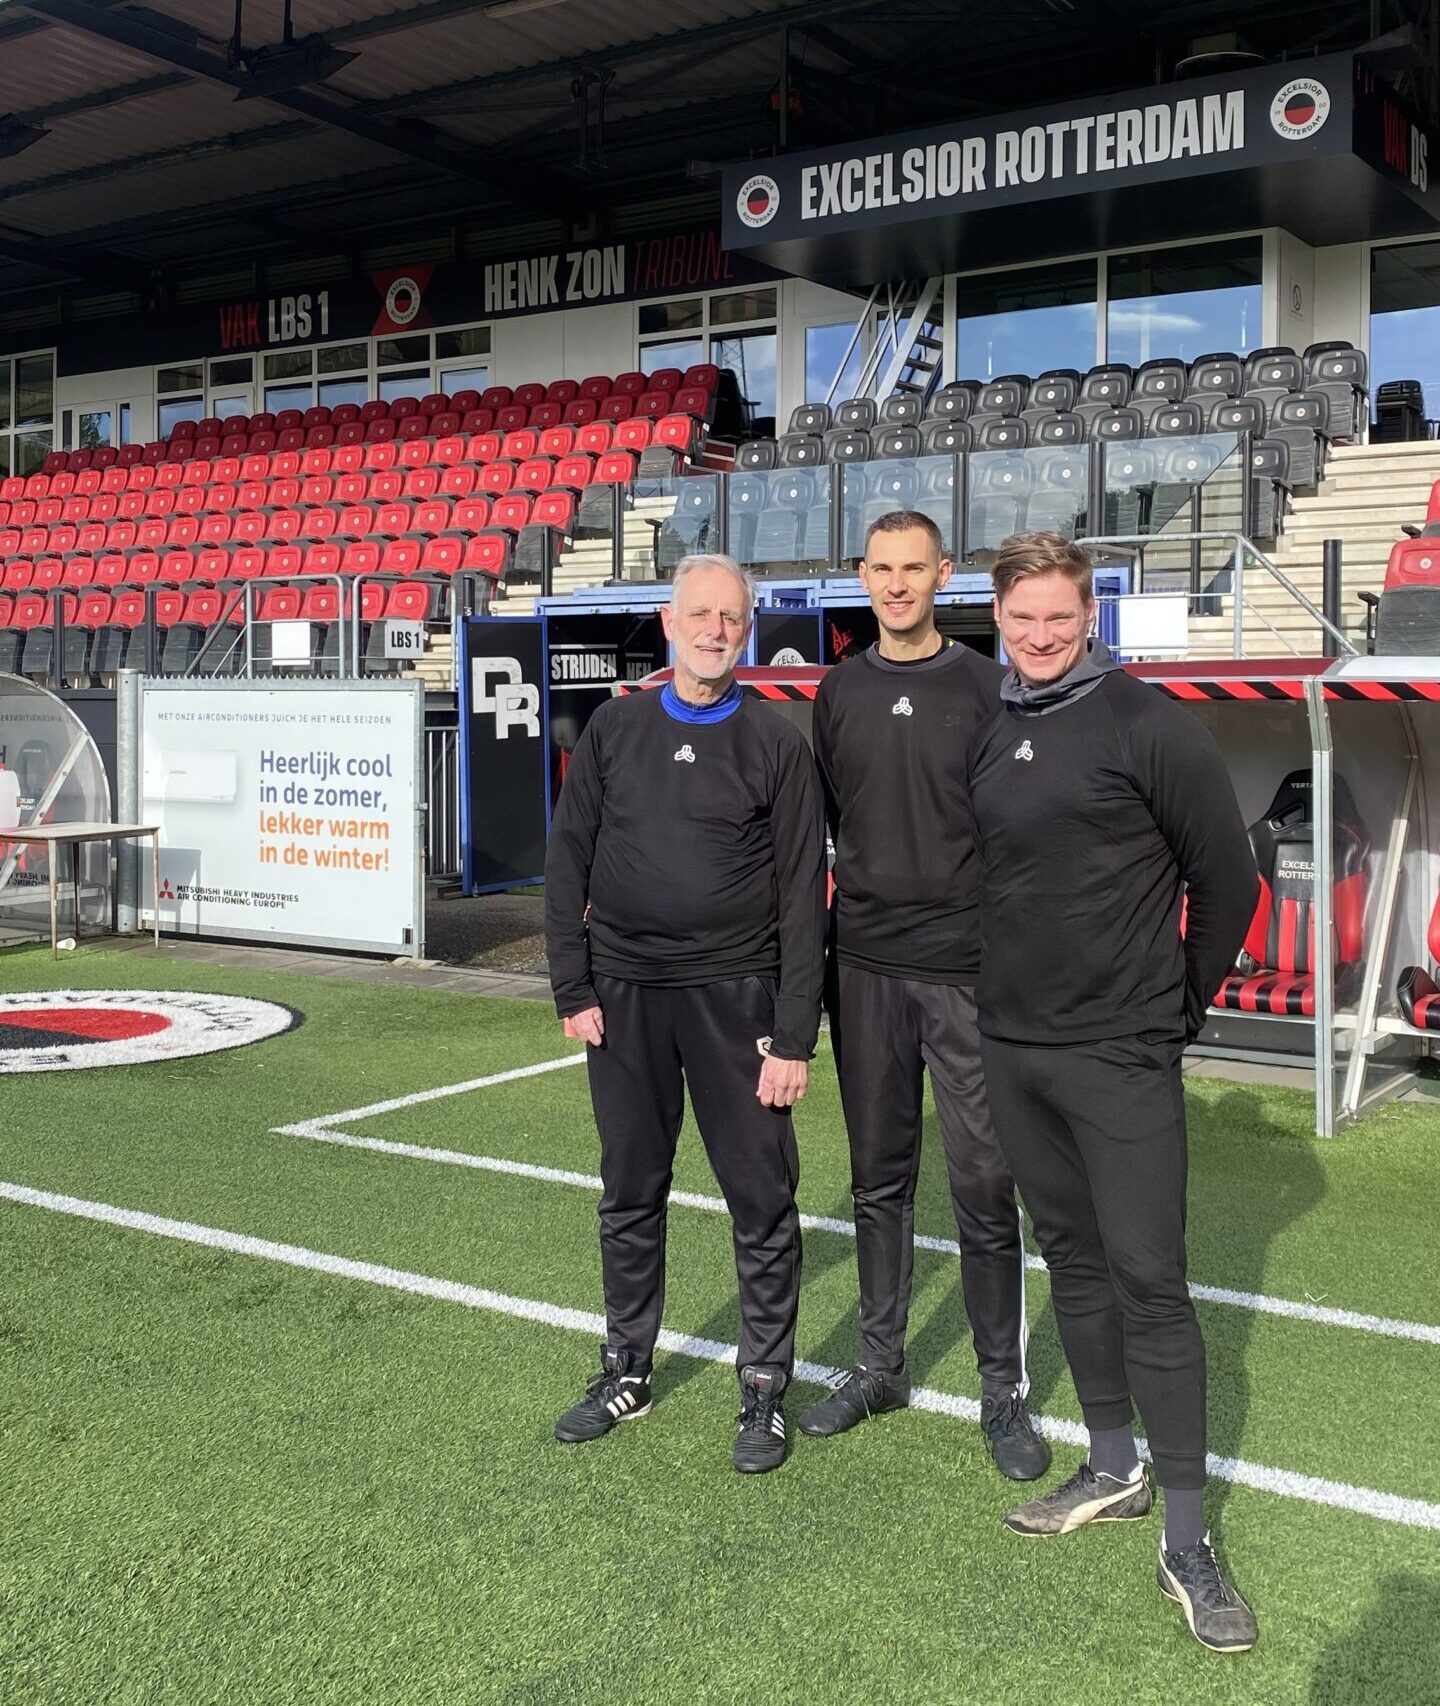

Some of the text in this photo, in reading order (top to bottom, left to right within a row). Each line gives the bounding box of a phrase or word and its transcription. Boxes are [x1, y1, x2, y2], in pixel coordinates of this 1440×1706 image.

[1278, 82, 1322, 104] EXCELSIOR
[1278, 115, 1322, 136] ROTTERDAM
[801, 90, 1245, 220] EXCELSIOR ROTTERDAM
[1411, 124, 1428, 193] DS
[742, 179, 775, 196] EXCELSIOR
[743, 207, 775, 224] ROTTERDAM
[484, 255, 560, 312] HENK
[566, 245, 625, 300] ZON
[219, 290, 329, 349] VAK LBS 1
[391, 631, 420, 649] LBS 1
[551, 653, 618, 681] STRIJDEN
[158, 712, 392, 725] MET ONZE AIRCONDITIONERS JUICH JE HET HELE SEIZOEN
[260, 750, 392, 781] Heerlijk cool
[260, 780, 387, 812] in de zomer,
[260, 810, 389, 840] lekker warm
[260, 840, 389, 872] in de winter!
[1282, 860, 1315, 870] EXCELS
[1278, 870, 1315, 880] ROTTER
[177, 885, 299, 902] MITSUBISHI HEAVY INDUSTRIES
[177, 893, 286, 910] AIR CONDITIONING EUROPE
